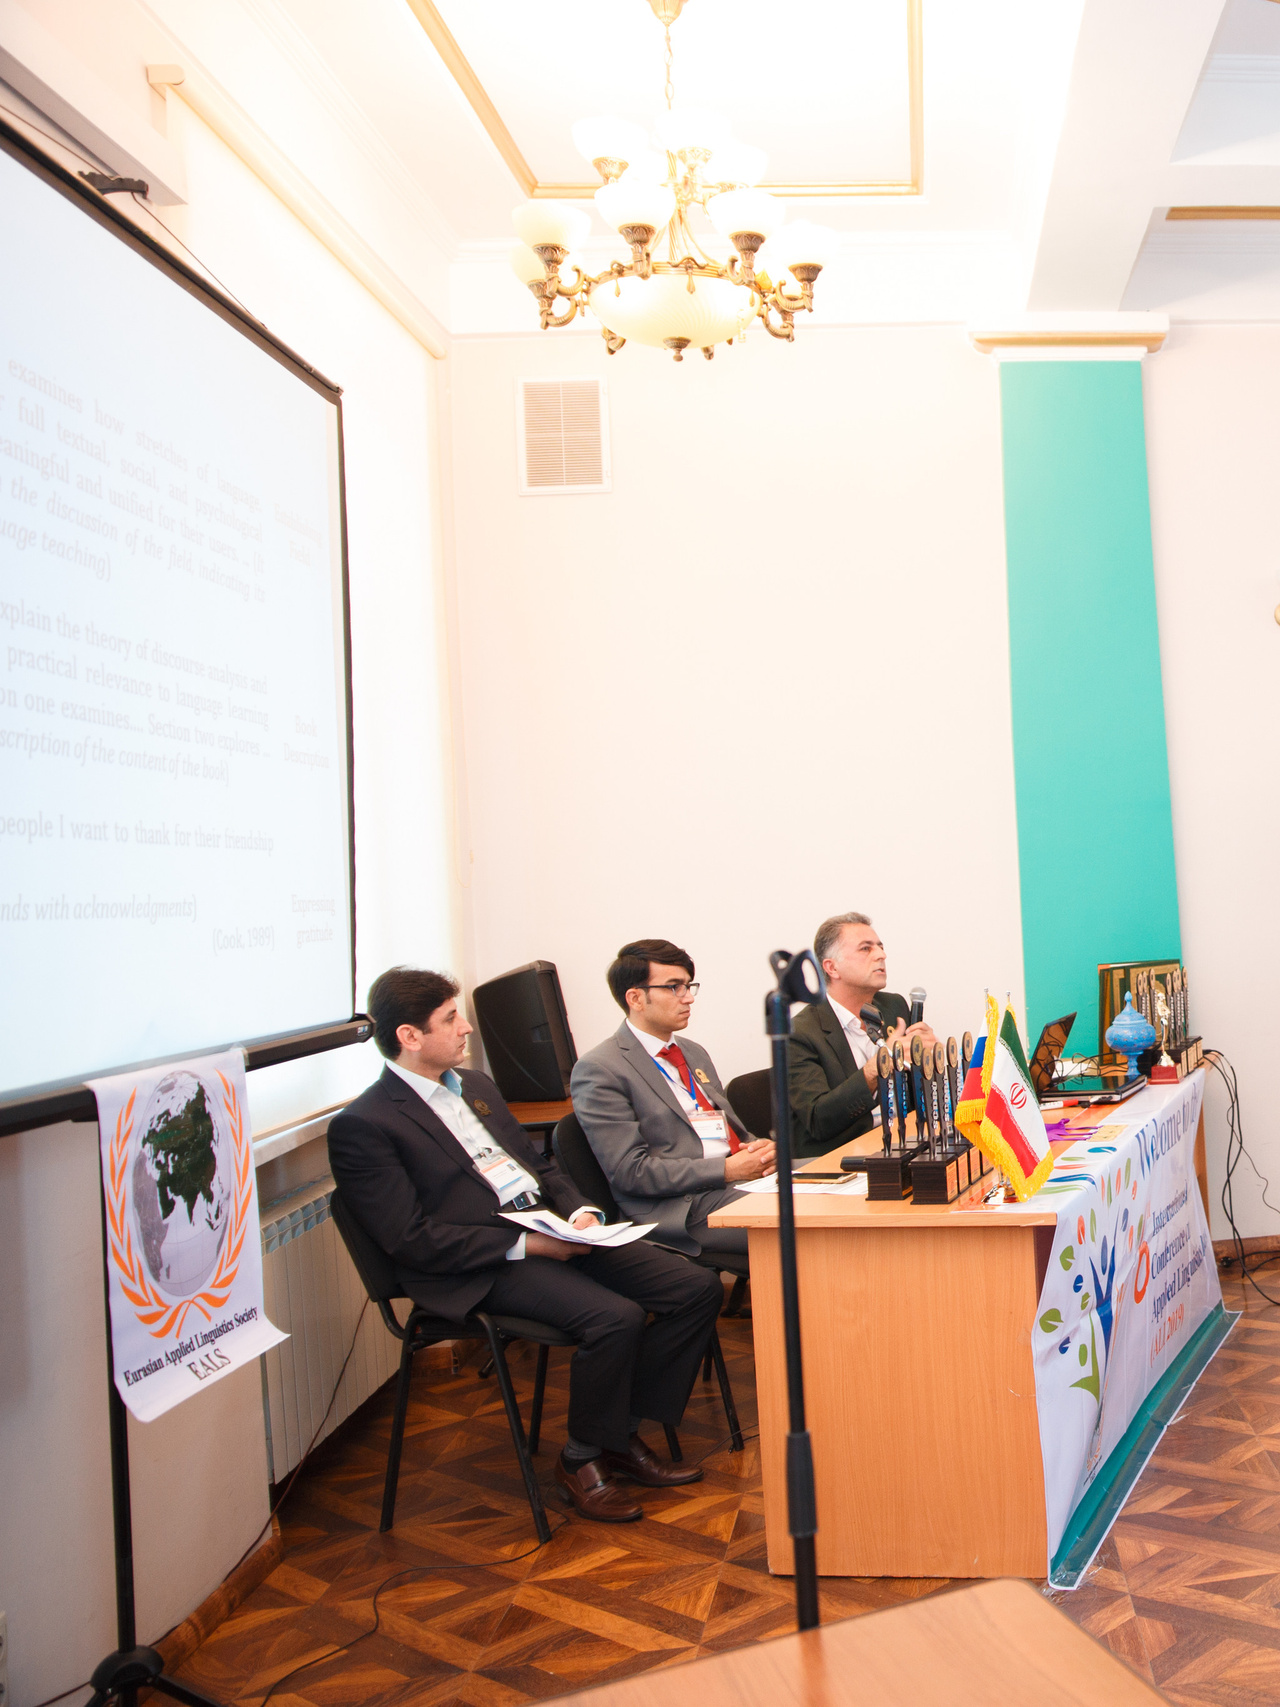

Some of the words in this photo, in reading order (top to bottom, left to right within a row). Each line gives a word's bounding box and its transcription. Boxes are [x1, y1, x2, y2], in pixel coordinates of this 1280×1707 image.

[8, 358, 83, 414] examines
[94, 398, 125, 435] how
[135, 430, 188, 472] stretches
[196, 463, 210, 483] of
[216, 468, 261, 513] language
[18, 396, 45, 433] full
[57, 420, 111, 467] textual,
[120, 457, 160, 493] social,
[168, 482, 189, 506] and
[195, 497, 262, 543] psychological
[0, 438, 70, 484] aningful
[76, 474, 104, 500] and
[108, 485, 154, 523] unified
[158, 504, 175, 533] for
[180, 518, 205, 546] their
[11, 475, 38, 508] the
[46, 490, 118, 542] discussion
[125, 528, 140, 556] of
[144, 535, 164, 561] the
[168, 543, 194, 576] field,
[199, 559, 251, 602] indicating
[41, 531, 111, 583] teaching)
[0, 598, 52, 633] xplain
[57, 611, 80, 641] the
[85, 620, 131, 661] theory
[136, 638, 150, 661] of
[152, 641, 205, 677] discourse
[207, 663, 248, 691] analysis
[250, 675, 268, 695] and
[7, 645, 78, 680] practical
[85, 661, 152, 698] relevance
[158, 684, 170, 703] to
[175, 682, 224, 720] language
[228, 696, 270, 732] learning
[24, 691, 55, 716] one
[148, 712, 191, 743] Section
[194, 728, 215, 746] two
[217, 730, 261, 757] explores
[0, 728, 70, 759] scription
[73, 735, 91, 767] of
[92, 737, 116, 764] the
[118, 748, 167, 773] content
[168, 751, 182, 780] of
[182, 754, 200, 777] the
[202, 757, 230, 788] book)
[59, 814, 65, 838] I
[70, 819, 109, 842] want
[114, 820, 129, 843] to
[134, 819, 171, 846] thank
[174, 823, 192, 847] for
[194, 824, 222, 849] their
[224, 827, 274, 857] friendship
[0, 893, 30, 922] nds
[34, 893, 70, 921] with
[73, 892, 198, 925] acknowledgments)
[212, 926, 245, 956] (Cook,
[247, 924, 275, 952] 1989)
[123, 1358, 165, 1387] Eurasian
[165, 1337, 195, 1367] Applied
[195, 1318, 234, 1348] Linguistics
[234, 1305, 259, 1328] Society
[187, 1348, 231, 1382] EALS
